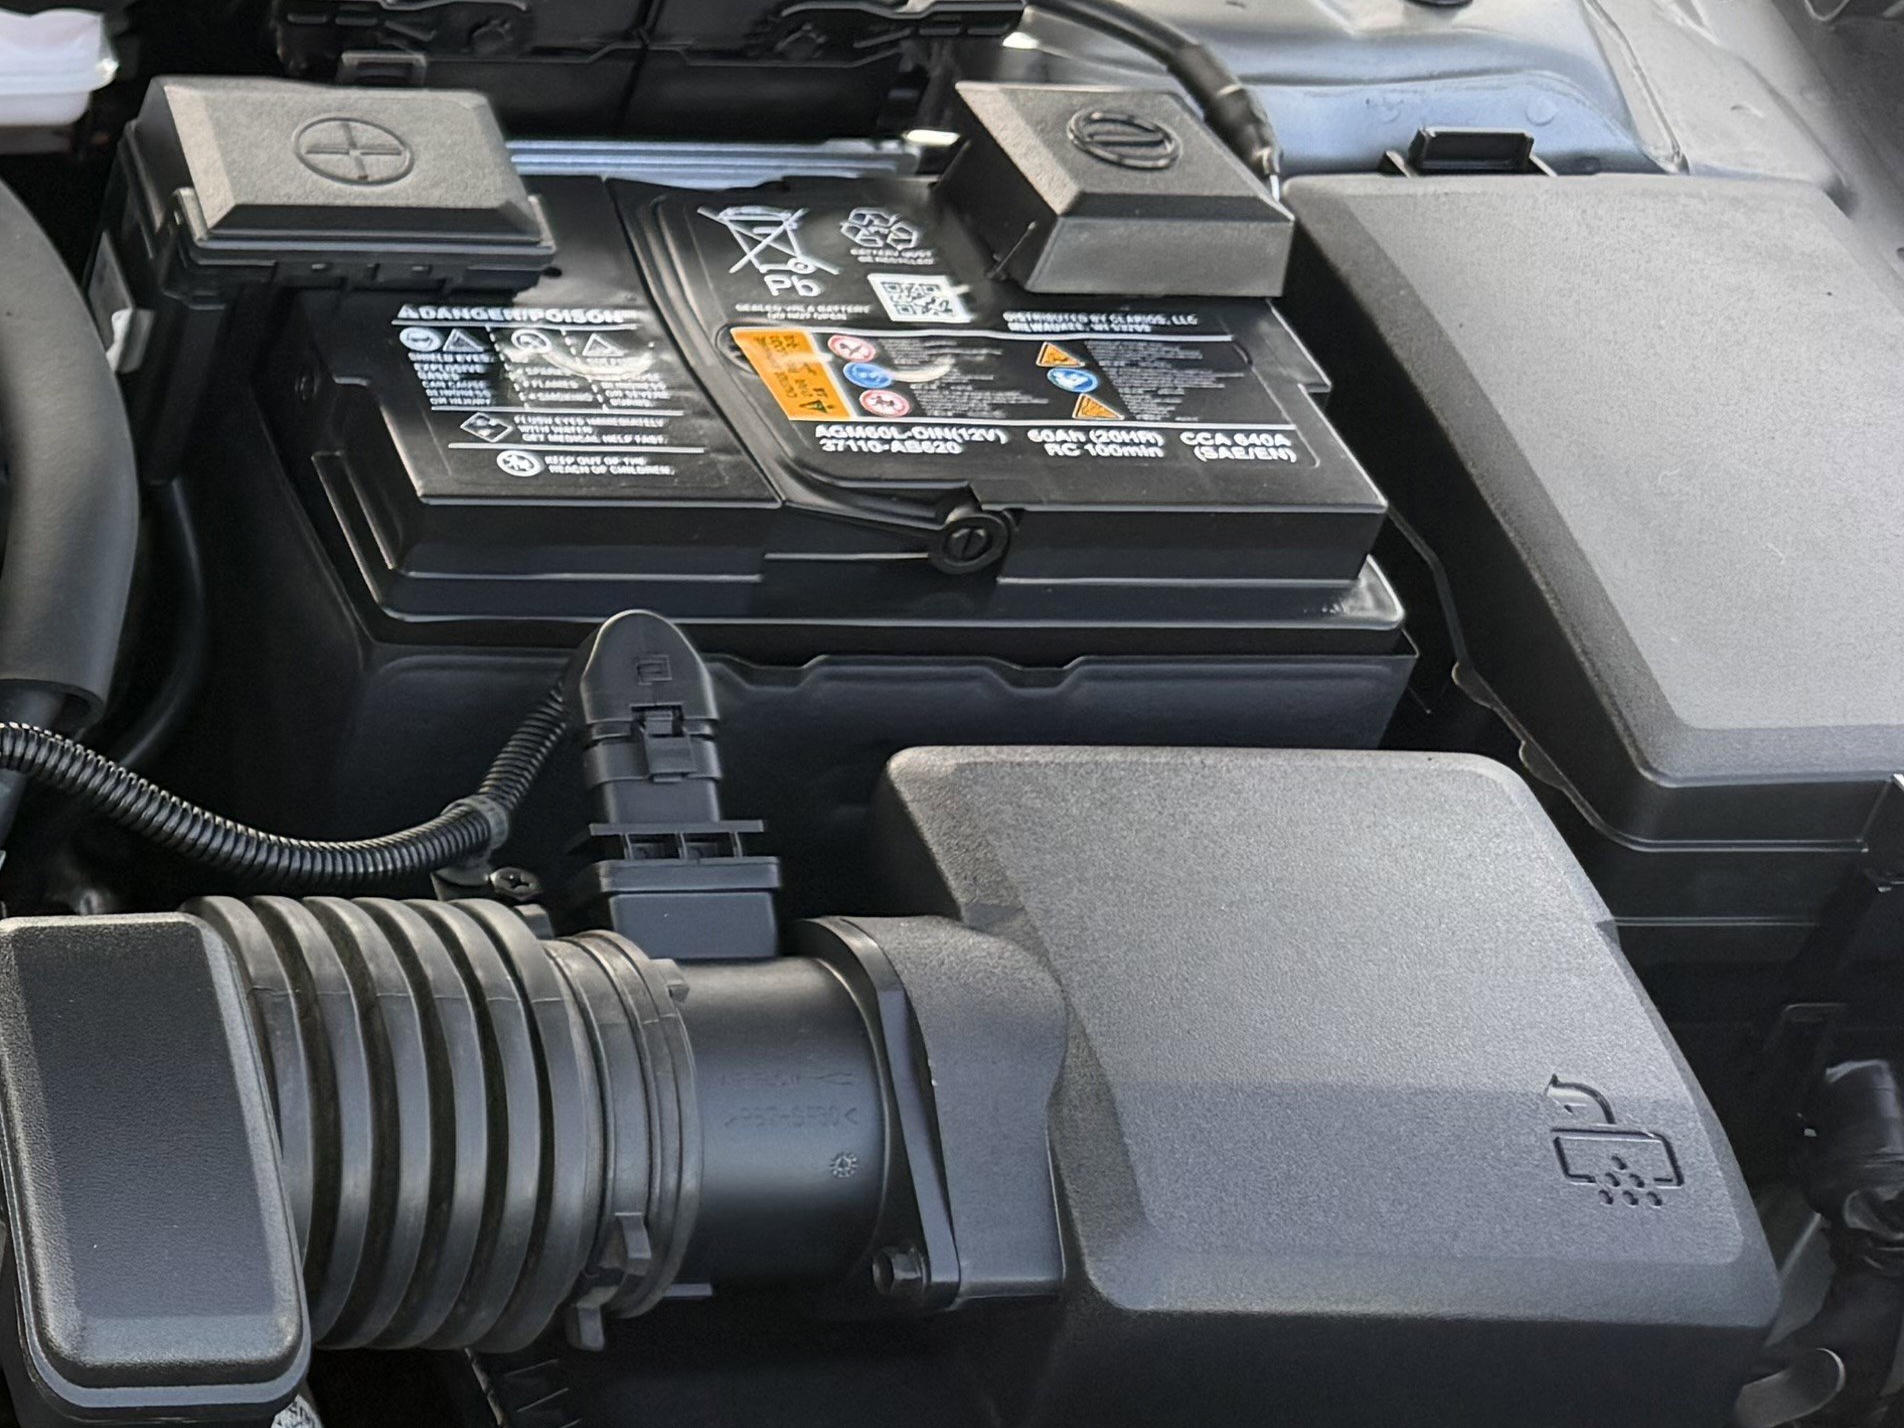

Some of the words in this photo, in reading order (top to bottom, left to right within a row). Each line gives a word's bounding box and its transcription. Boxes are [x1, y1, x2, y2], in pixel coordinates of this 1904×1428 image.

[764, 274, 823, 297] Pb
[419, 307, 625, 323] DANGER/POISON
[1172, 315, 1198, 325] LLC
[1027, 428, 1086, 443] 60Ah
[1089, 429, 1165, 447] (20HR)
[1180, 431, 1232, 447] CCA
[1044, 443, 1083, 457] RC
[1084, 443, 1164, 458] 100min
[1194, 446, 1297, 462] (SAE/EN)
